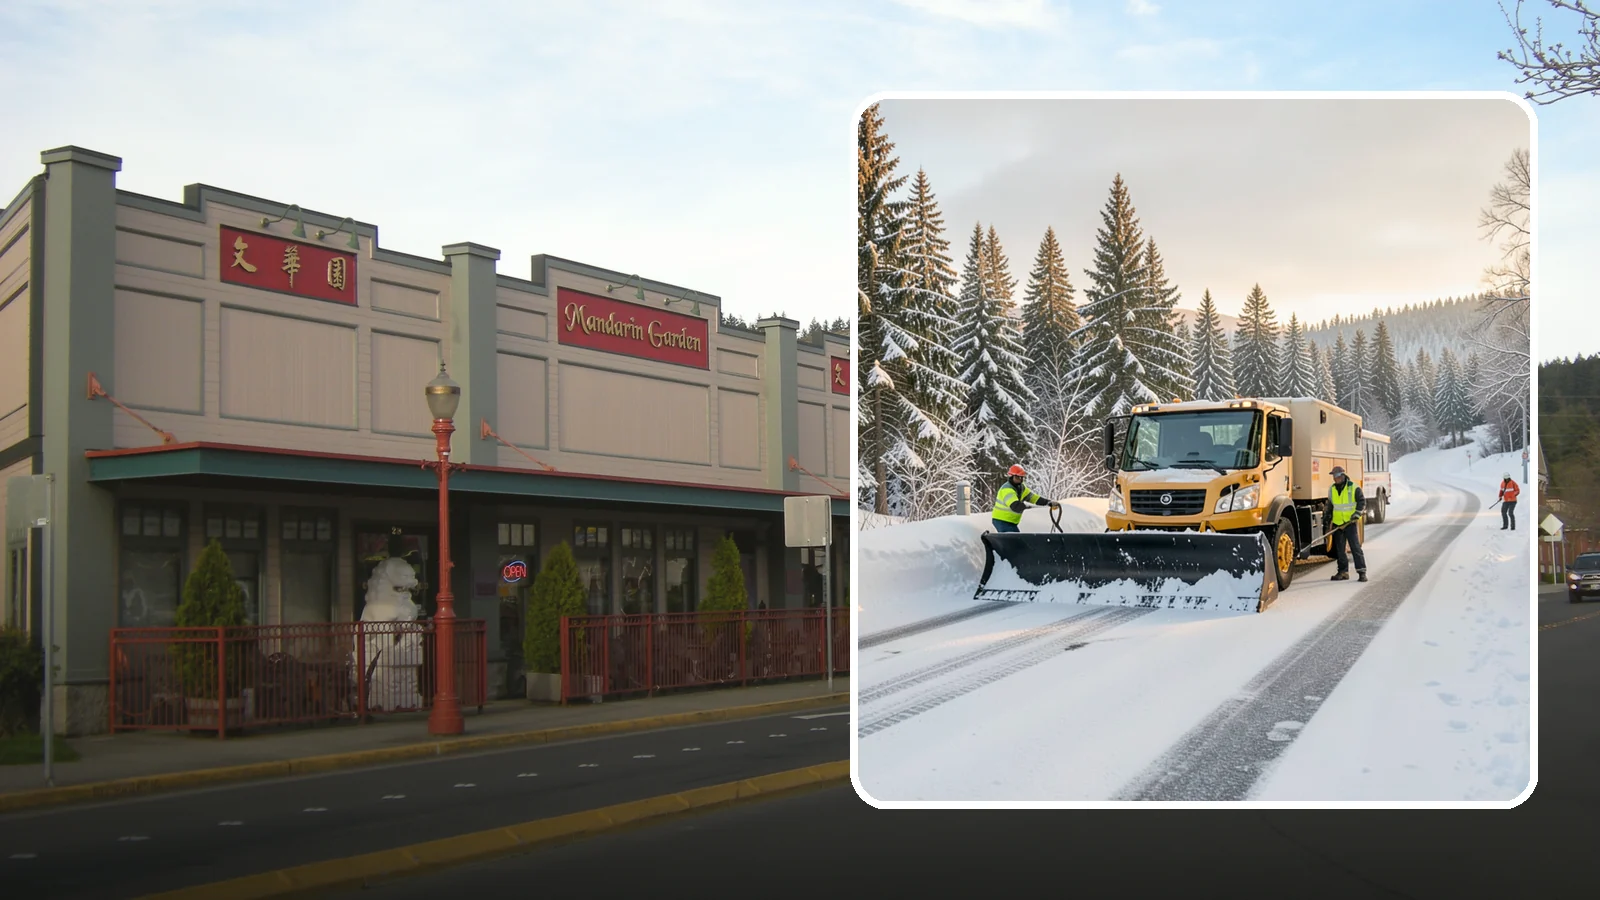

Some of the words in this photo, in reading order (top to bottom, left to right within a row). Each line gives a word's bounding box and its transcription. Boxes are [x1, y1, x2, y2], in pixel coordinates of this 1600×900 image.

[231, 236, 346, 291] 文華園
[564, 302, 644, 341] Mandarin
[648, 320, 701, 352] Garden
[503, 565, 527, 578] OPEN
